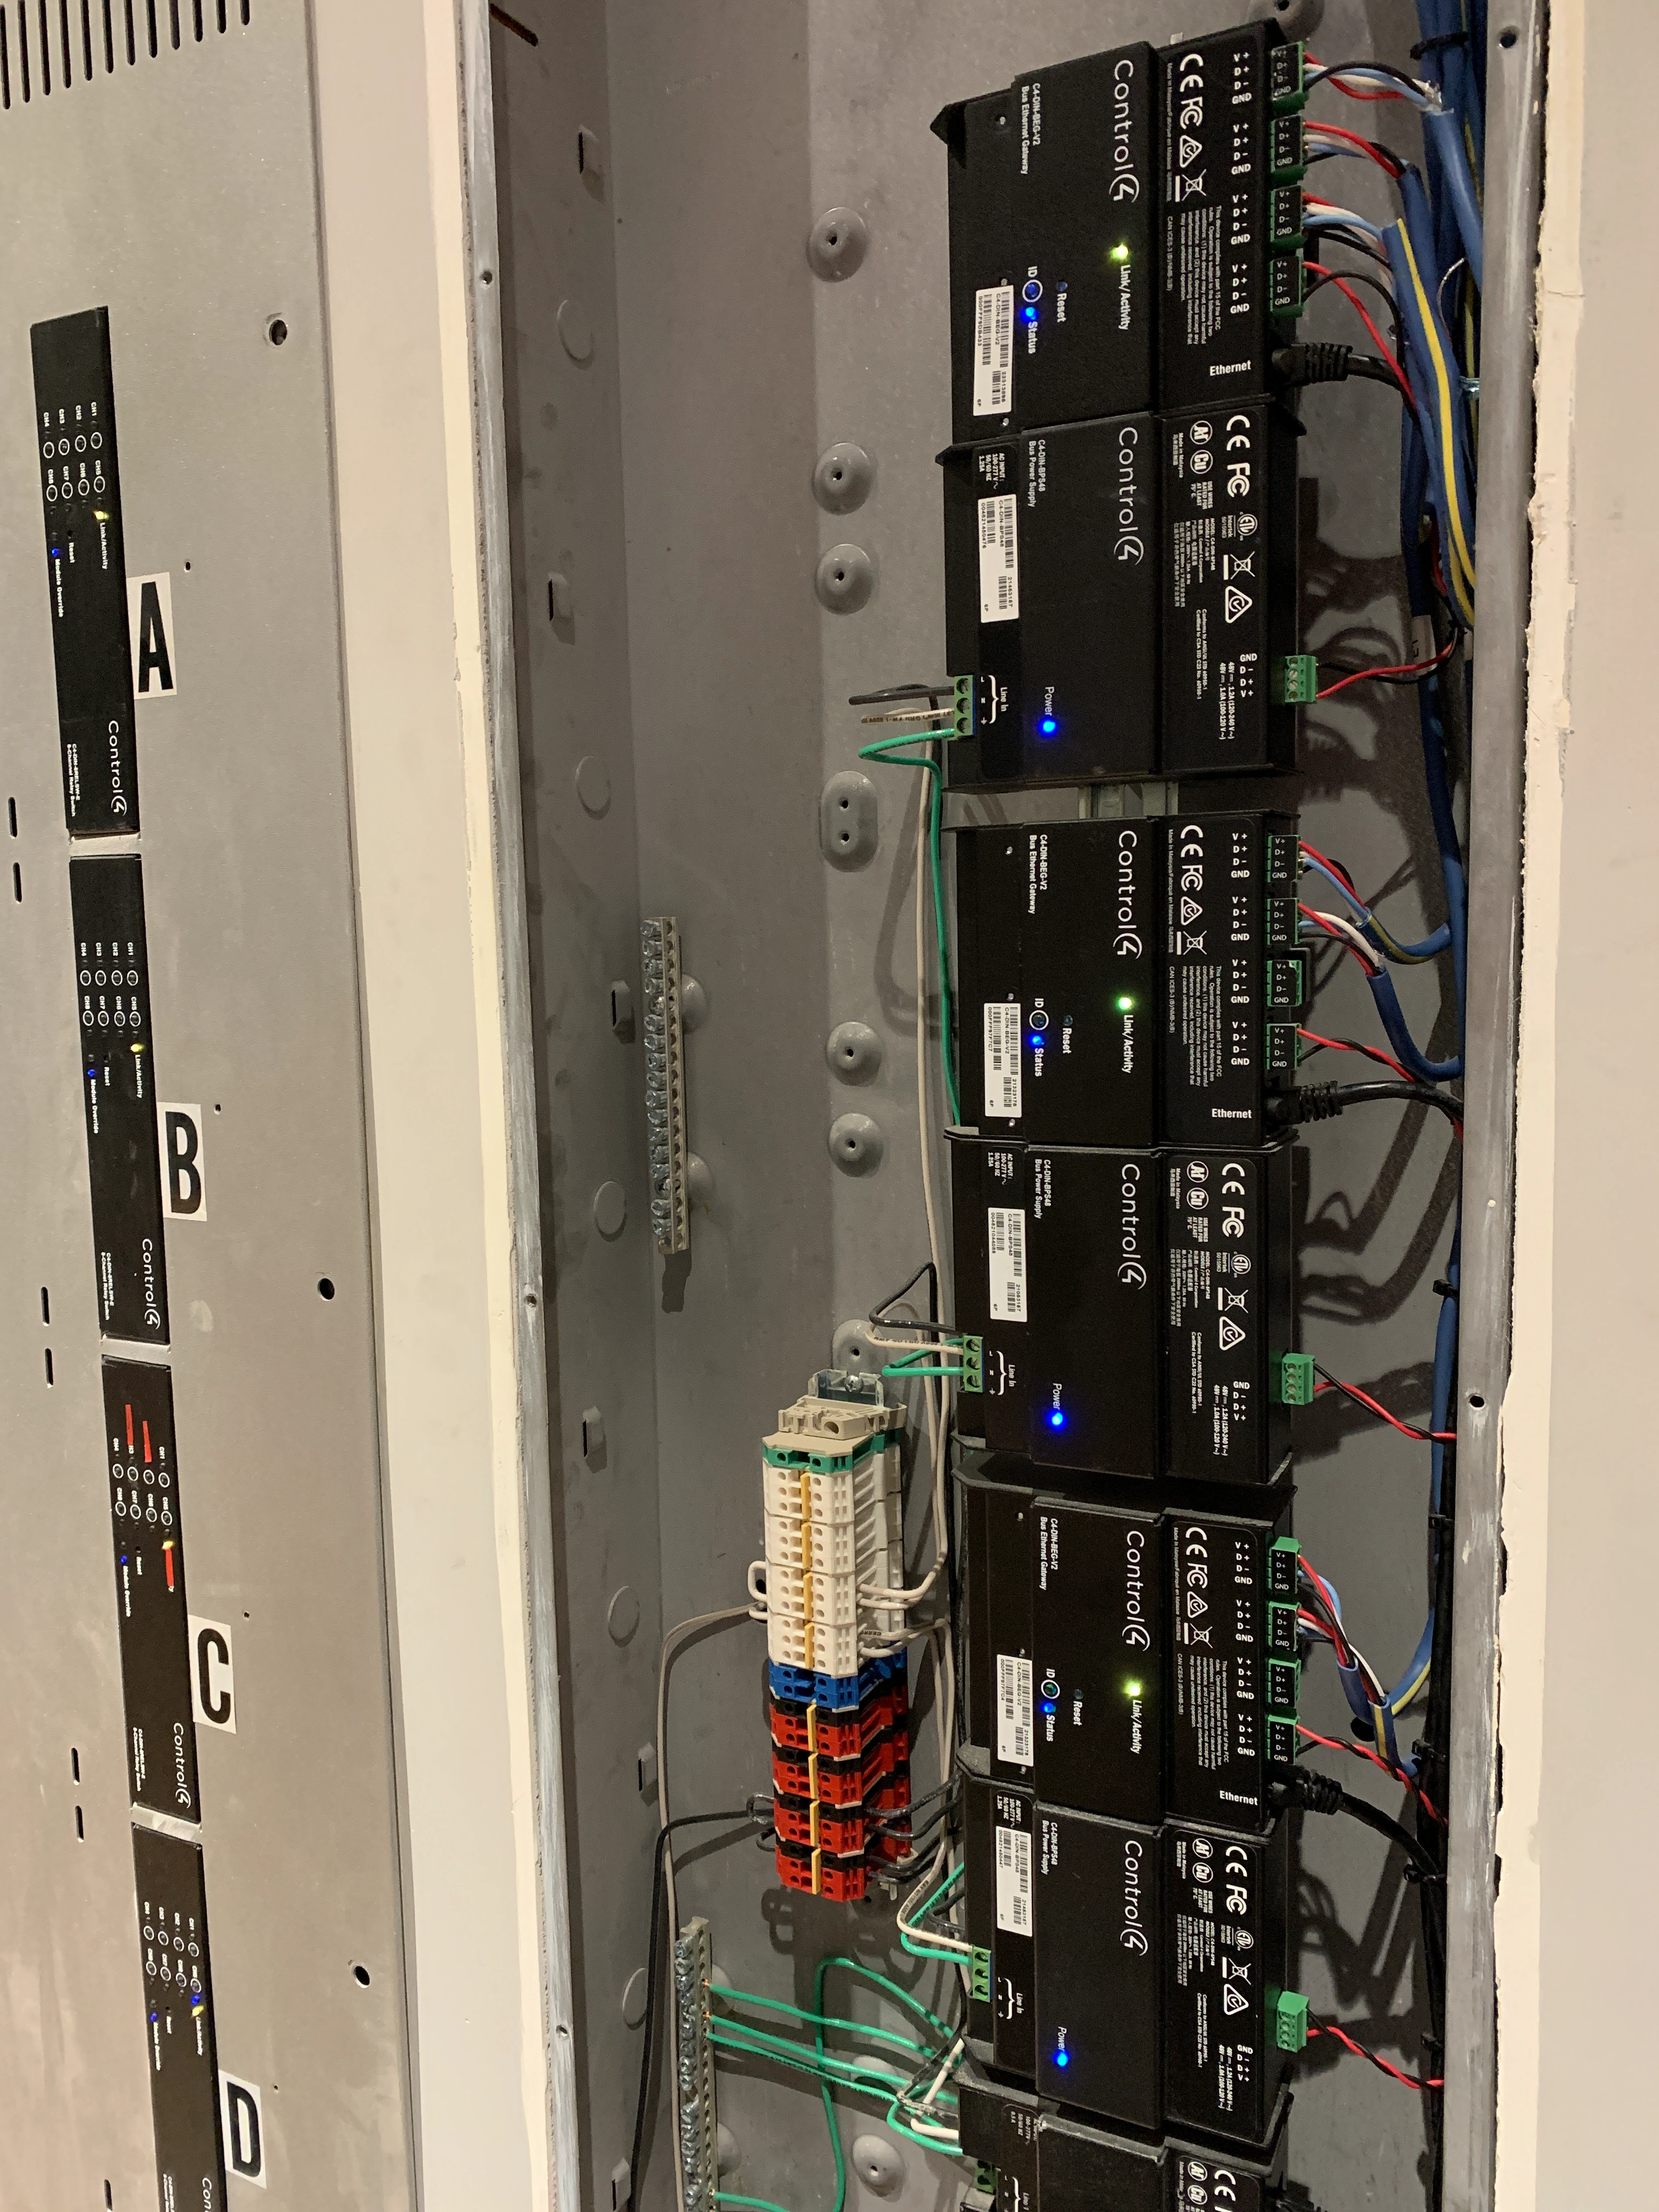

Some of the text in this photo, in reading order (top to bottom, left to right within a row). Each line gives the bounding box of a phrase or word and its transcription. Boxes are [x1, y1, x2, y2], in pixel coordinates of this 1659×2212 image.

[1232, 93, 1251, 104] GND
[1020, 140, 1030, 174] Gateway
[1231, 163, 1251, 174] GND
[1231, 234, 1250, 245] GND
[1028, 266, 1037, 277] ID
[1057, 293, 1066, 322] Reset
[1119, 264, 1131, 329] Link/Activity
[1231, 303, 1249, 313] GND
[1028, 321, 1038, 354] Status
[1210, 360, 1251, 376] Ethernet
[1028, 482, 1036, 506] Supply
[138, 582, 173, 692] A
[1240, 653, 1257, 662] GND
[1045, 686, 1054, 716] Power
[1028, 883, 1037, 913] Gateway
[1035, 998, 1043, 1007] ID
[1063, 1028, 1072, 1053] Reset
[1122, 1015, 1133, 1073] Link/Activity
[1035, 1048, 1044, 1077] Status
[1212, 1109, 1251, 1118] Ethernet
[165, 1111, 201, 1214] B
[1034, 1196, 1042, 1218] Supply
[1052, 1383, 1062, 1410] Power
[1039, 1561, 1048, 1590] Gateway
[1235, 1576, 1252, 1584] GND
[1236, 1634, 1253, 1642] GND
[197, 1628, 232, 1724] C
[1047, 1668, 1055, 1678] ID
[1237, 1691, 1254, 1699] GND
[1074, 1701, 1082, 1725] Reset
[1046, 1714, 1055, 1742] Status
[1131, 1700, 1142, 1754] Link/Activity
[1238, 1747, 1255, 1756] GND
[1220, 1791, 1257, 1805] Ethernet
[1041, 1854, 1049, 1875] Supply
[1058, 2027, 1066, 2052] Power
[1238, 2045, 1253, 2054] GND
[227, 2081, 261, 2177] D
